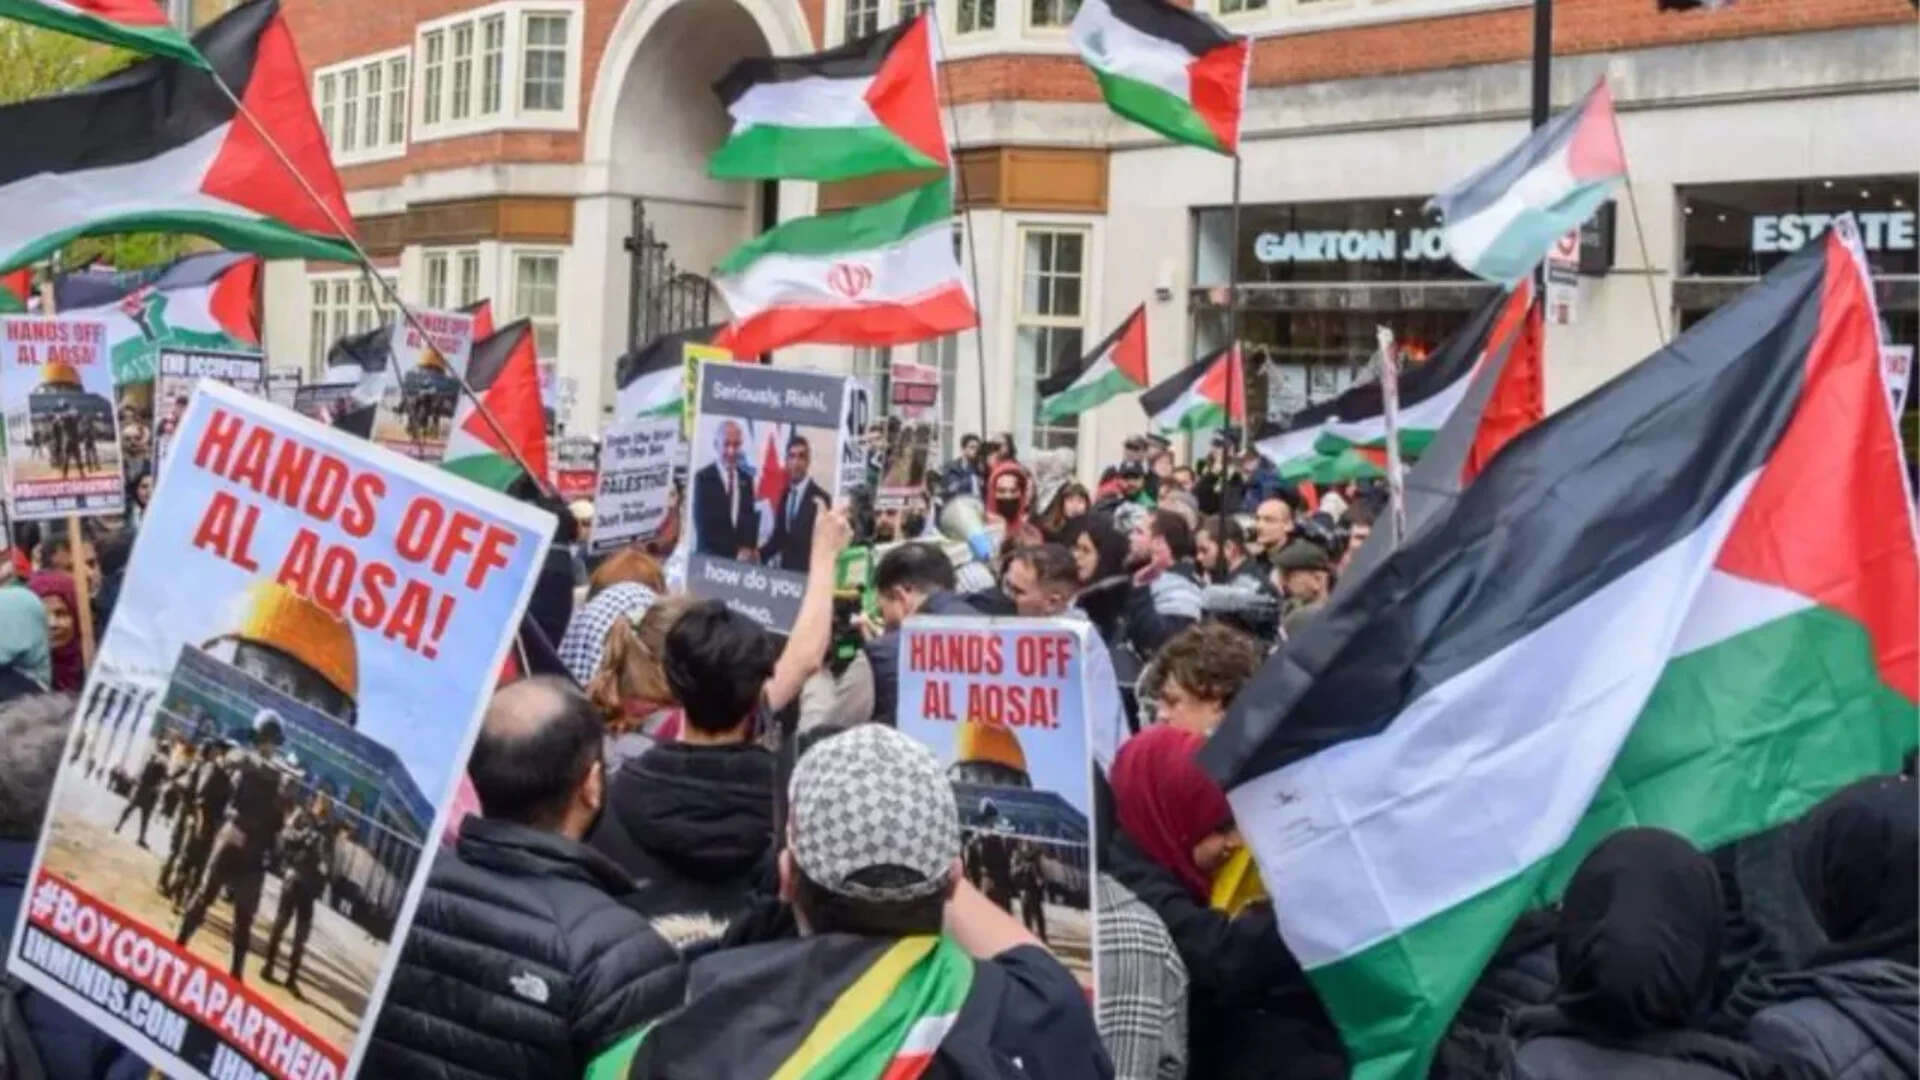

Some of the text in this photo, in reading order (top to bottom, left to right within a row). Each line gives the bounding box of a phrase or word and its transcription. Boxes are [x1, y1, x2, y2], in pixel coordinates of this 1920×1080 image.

[1254, 227, 1450, 262] GARTON JO
[1753, 212, 1914, 253] ESTTE
[7, 322, 105, 342] HANDS OFF
[18, 345, 40, 364] AL
[193, 408, 518, 590] HANDS OFF
[193, 490, 456, 660] AL AQSA!
[705, 561, 803, 598] how do you
[910, 634, 1072, 678] HANDS OFF
[923, 681, 1060, 729] AL AQSA!
[21, 926, 188, 1054] INMINDS.COM
[30, 880, 339, 1080] #BOYCOTTAPARTHEID
